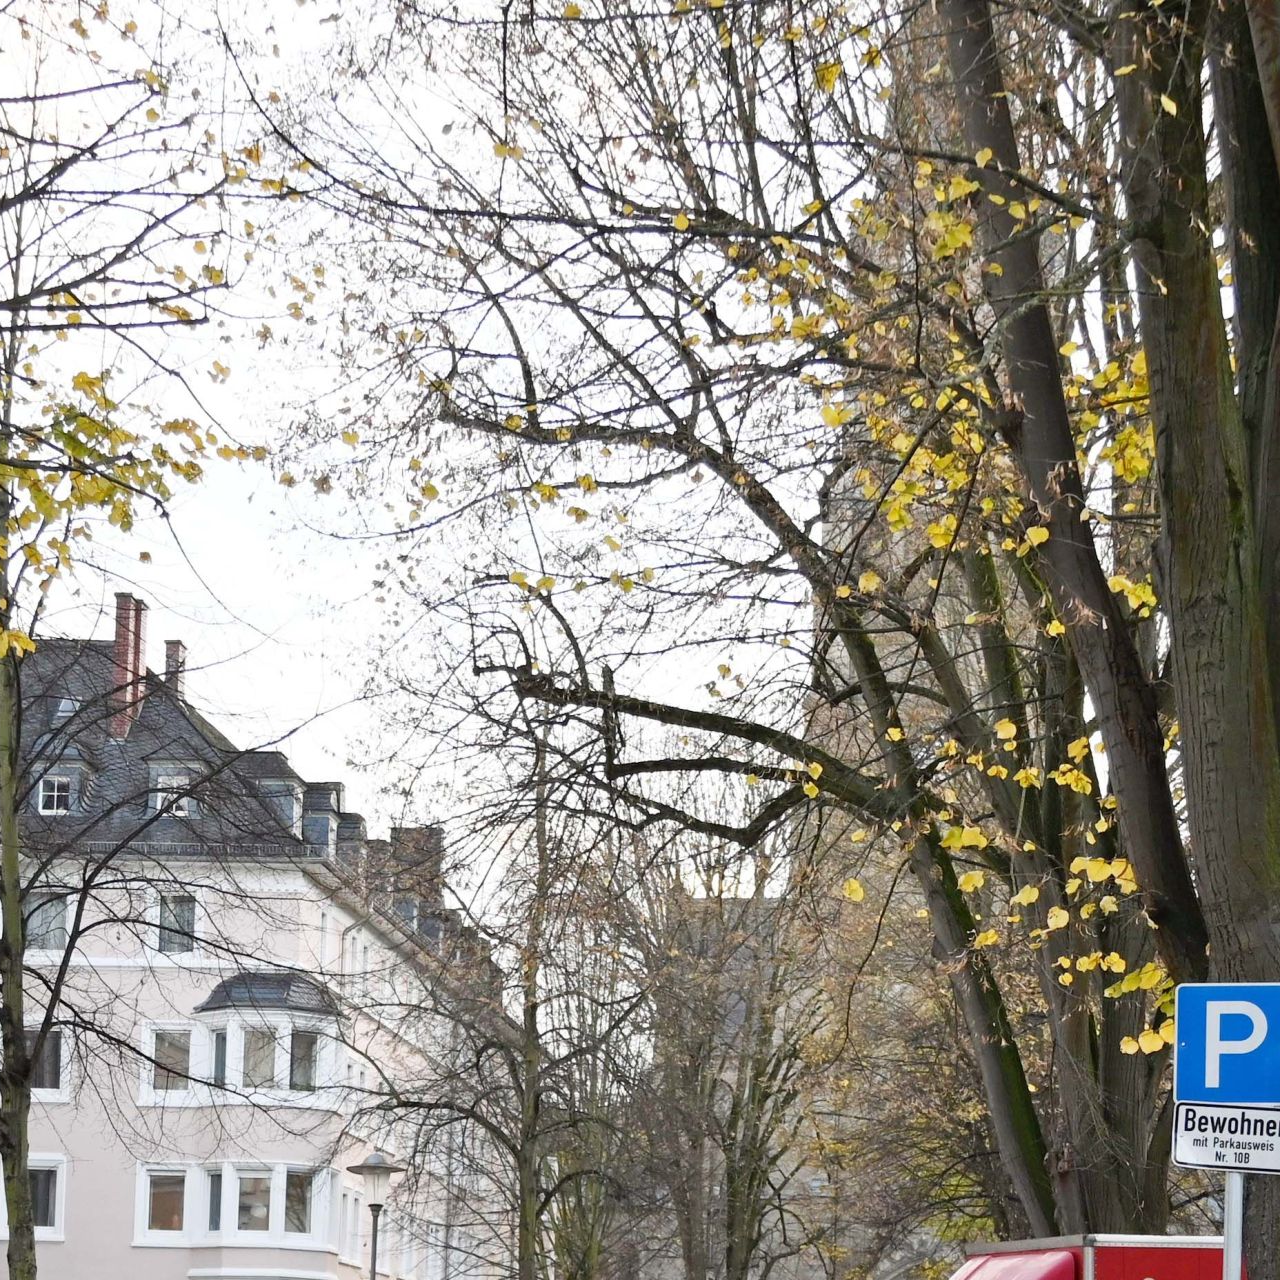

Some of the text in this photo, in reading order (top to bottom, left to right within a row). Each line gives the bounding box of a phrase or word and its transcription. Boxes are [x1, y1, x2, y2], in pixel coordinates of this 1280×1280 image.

[1204, 1000, 1268, 1089] P
[1192, 1136, 1274, 1152] mit Parkausweis
[1215, 1151, 1250, 1164] Nr. 10B
